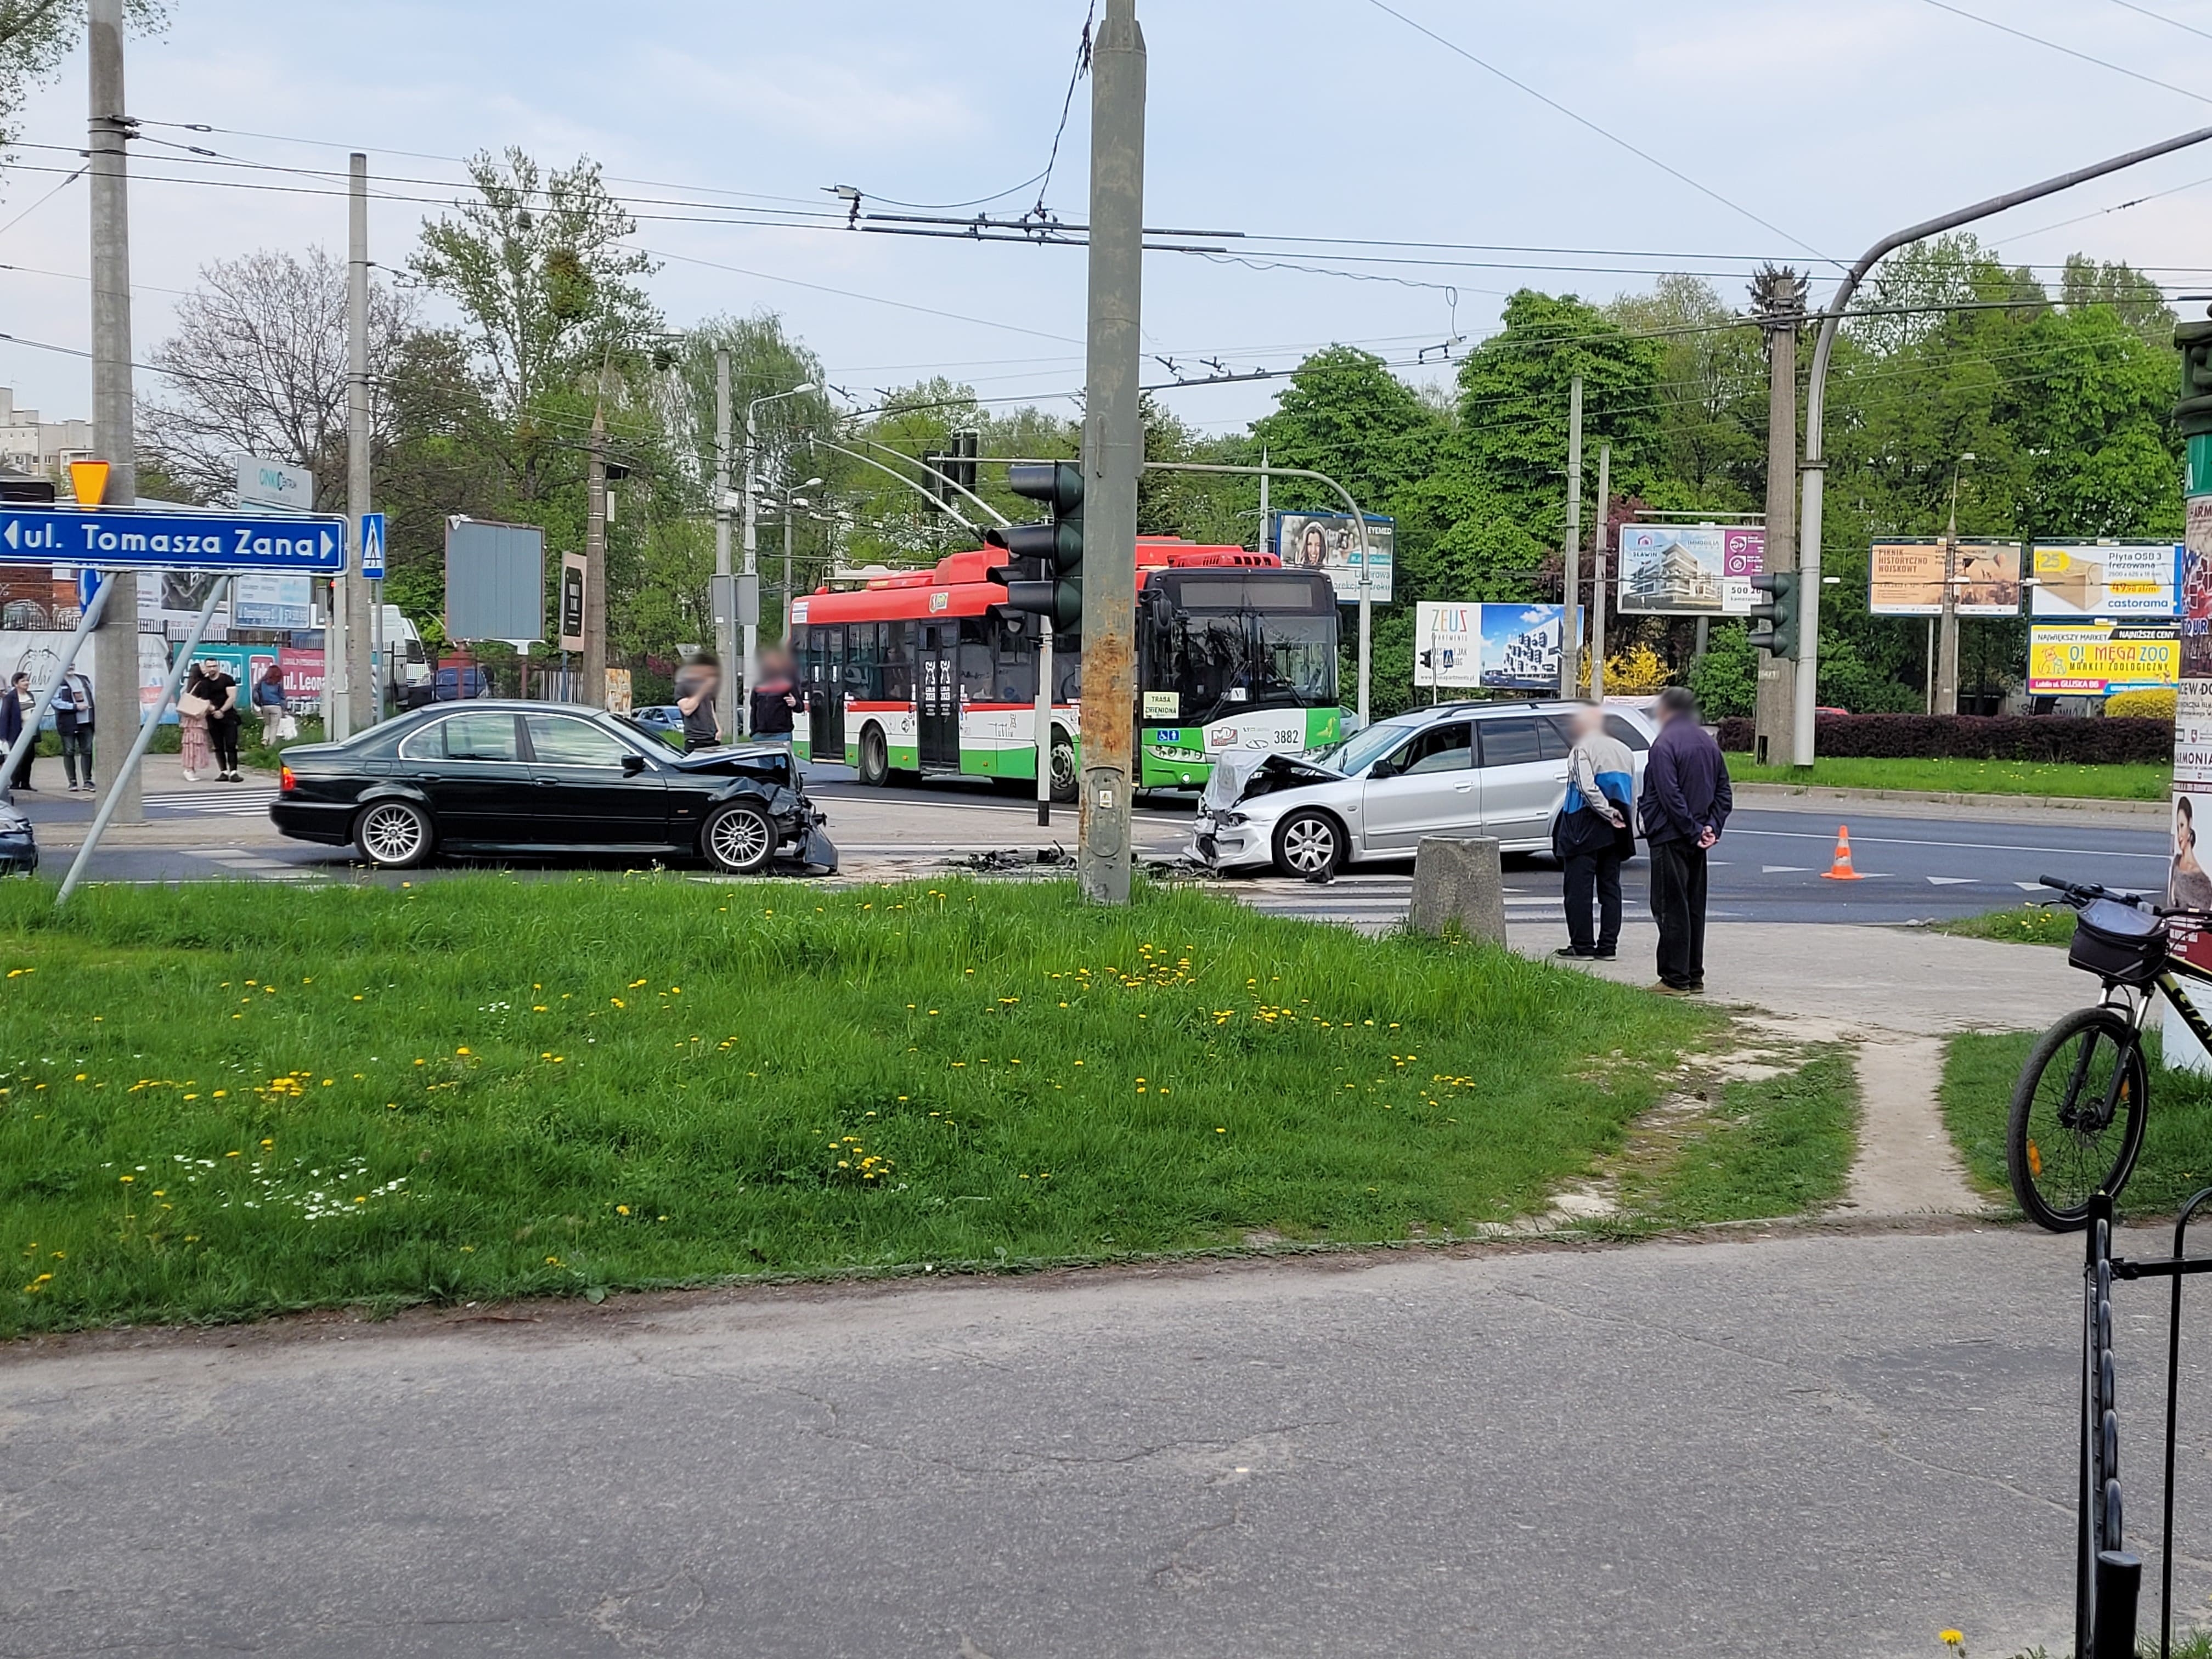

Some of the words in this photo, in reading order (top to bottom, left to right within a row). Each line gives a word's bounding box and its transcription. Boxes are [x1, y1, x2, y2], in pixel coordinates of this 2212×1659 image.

[25, 523, 64, 548] ul.
[81, 524, 222, 554] Tomasza
[234, 529, 315, 556] Zana
[2108, 599, 2168, 608] castorama
[2140, 647, 2168, 662] ZOO
[2108, 663, 2168, 671] ZOOLOGICZNY
[1274, 730, 1299, 744] 3882
